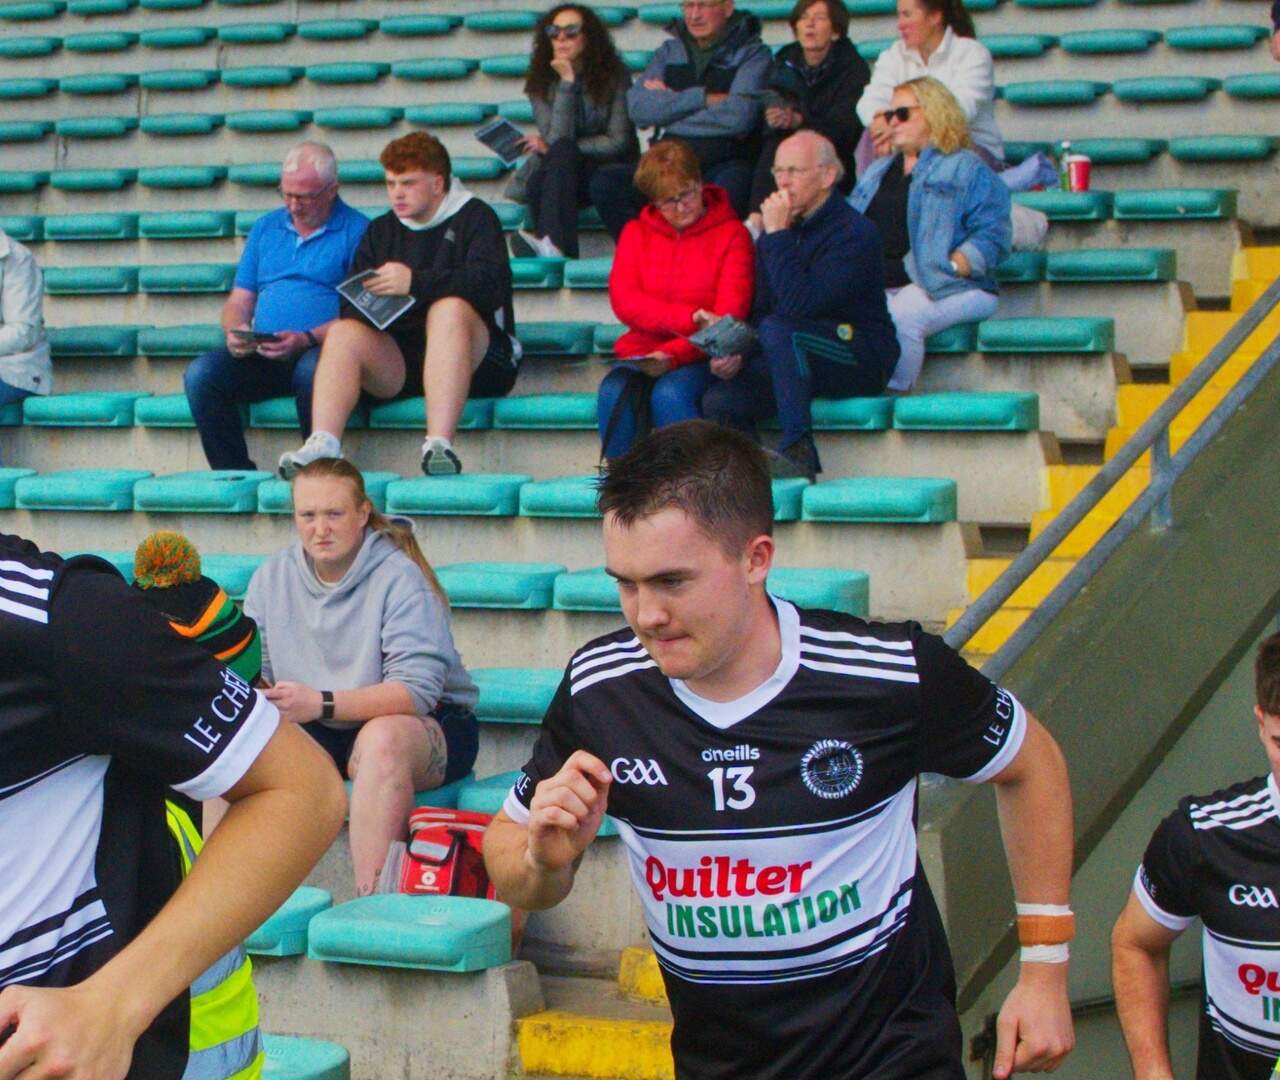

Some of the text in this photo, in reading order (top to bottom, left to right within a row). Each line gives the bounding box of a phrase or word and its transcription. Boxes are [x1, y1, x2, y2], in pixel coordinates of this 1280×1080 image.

[706, 765, 757, 812] 13
[645, 855, 813, 902] Quilter
[666, 878, 863, 939] INSULATION
